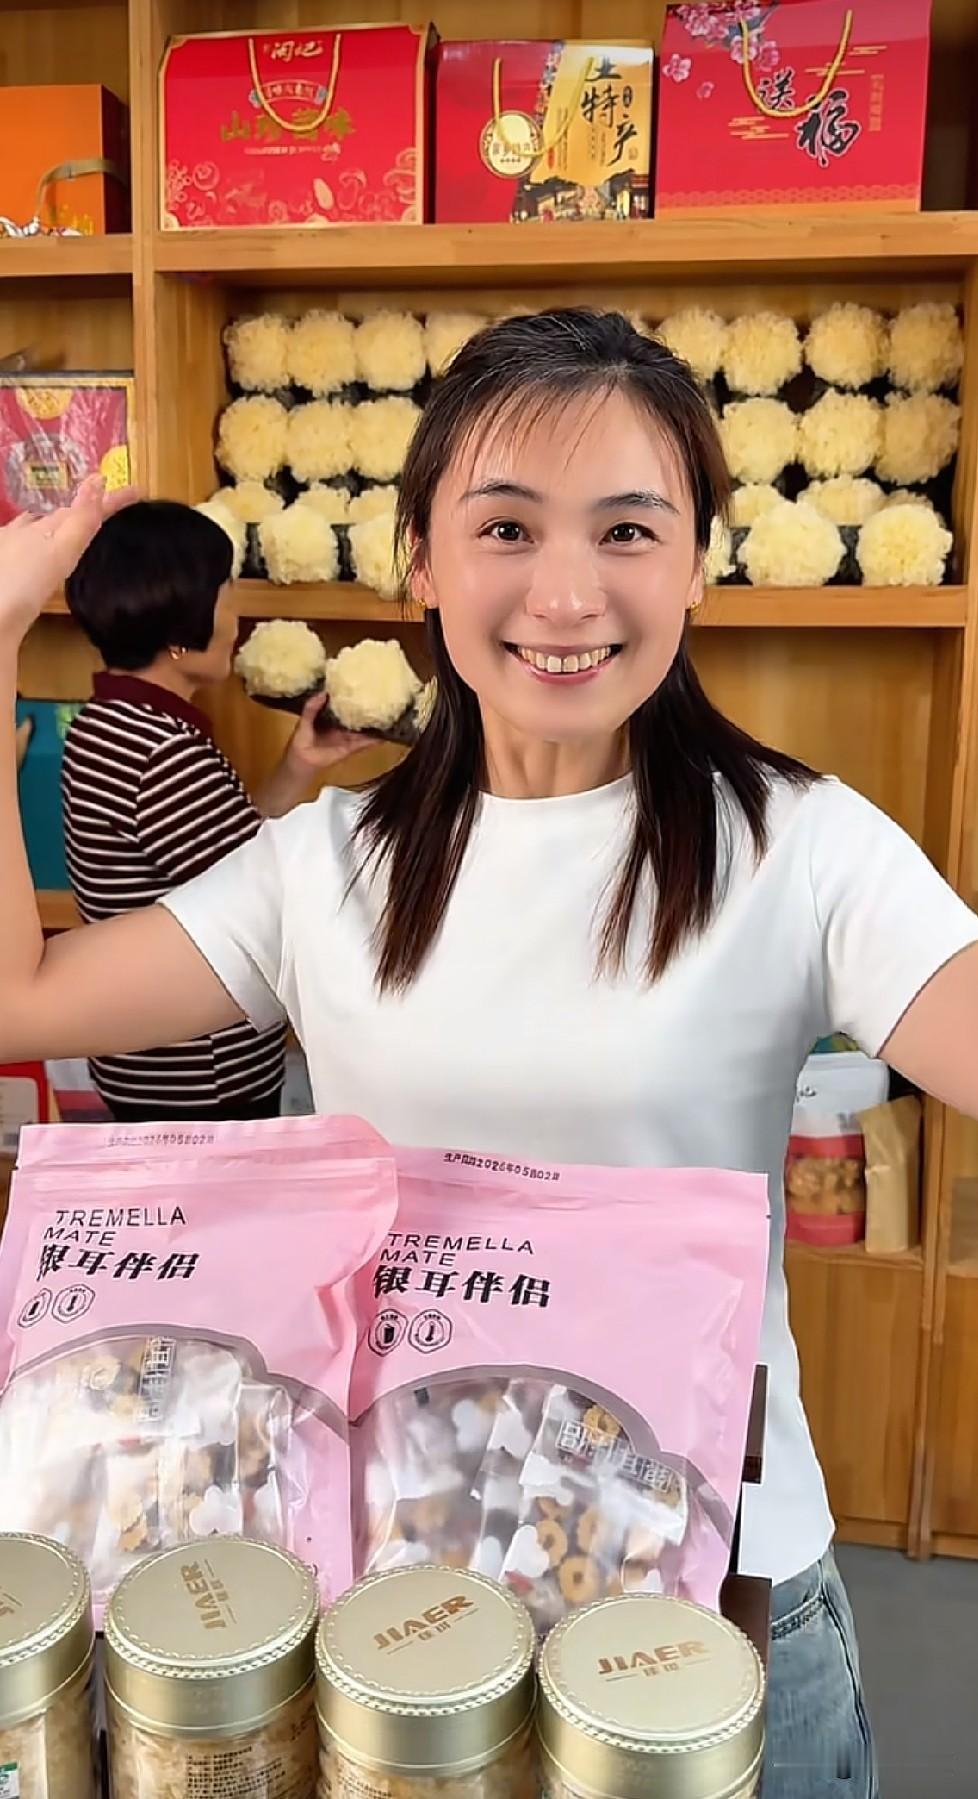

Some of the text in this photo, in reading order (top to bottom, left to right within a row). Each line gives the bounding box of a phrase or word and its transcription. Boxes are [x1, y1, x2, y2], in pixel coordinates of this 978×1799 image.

[56, 1206, 186, 1227] TREMELLA
[43, 1227, 117, 1246] MATE
[388, 1233, 534, 1255] TREMELLA
[380, 1249, 456, 1266] MATE
[373, 1265, 550, 1307] 银耳伴侣
[374, 1595, 474, 1649] JIAER
[598, 1640, 710, 1675] JIAER
